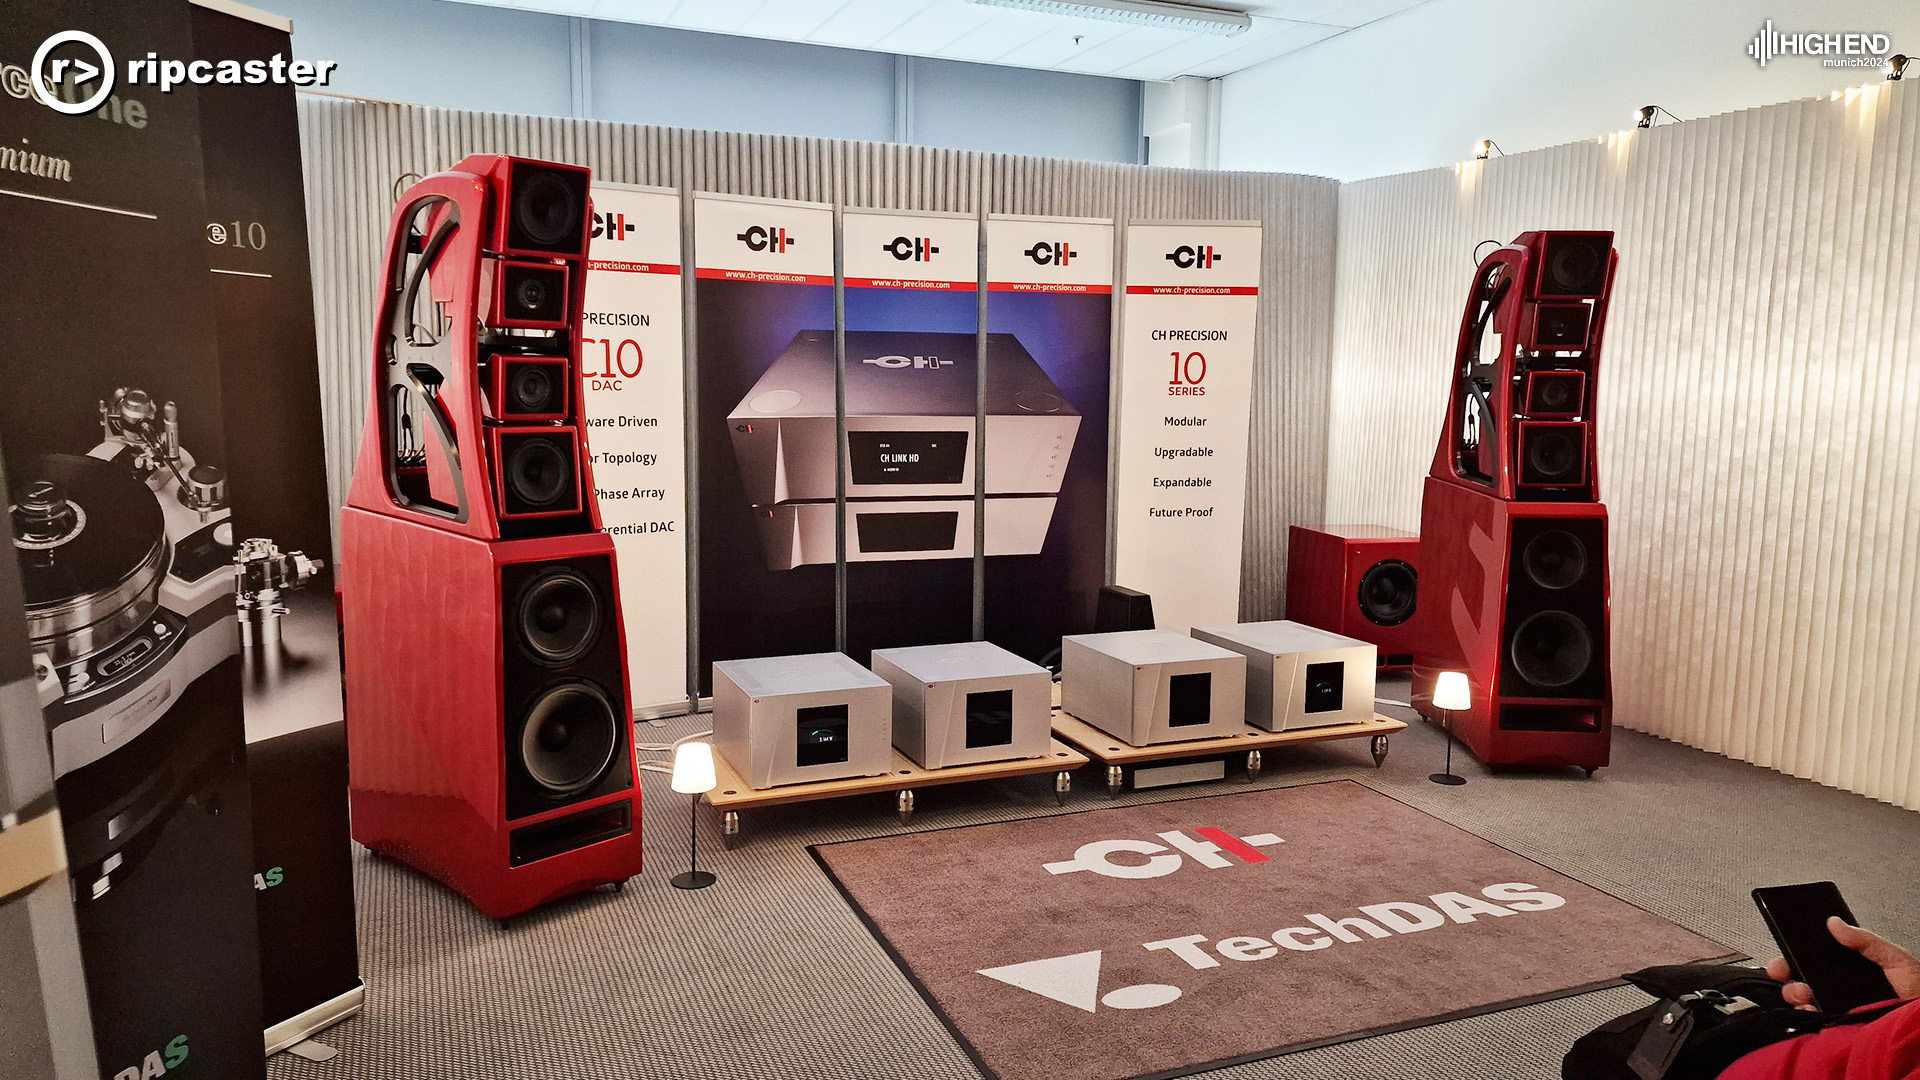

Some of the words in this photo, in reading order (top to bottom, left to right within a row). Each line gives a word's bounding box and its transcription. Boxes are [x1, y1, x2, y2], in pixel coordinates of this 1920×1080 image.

[726, 271, 806, 282] www.ch-precision.com
[872, 280, 950, 289] www.ch-precision.com
[1013, 283, 1087, 292] www.ch-precision.com
[1153, 287, 1231, 295] www.ch-precision.com
[1151, 329, 1167, 341] CH
[1169, 329, 1228, 341] PRECISION
[1169, 351, 1207, 385] 10
[592, 380, 623, 391] DAC
[1168, 386, 1206, 396] SERIES
[618, 415, 658, 427] Driven
[1164, 416, 1207, 426] Modular
[602, 451, 657, 466] Topology
[880, 453, 890, 463] CH
[891, 453, 908, 463] LINK
[909, 453, 920, 463] HD
[1154, 447, 1214, 459] Upgradable
[1153, 477, 1212, 489] Expandable
[632, 487, 666, 501] Array
[1149, 507, 1183, 517] Future
[1185, 506, 1214, 517] Proof
[650, 520, 675, 533] DAC
[1142, 882, 1567, 970] TechDAS
